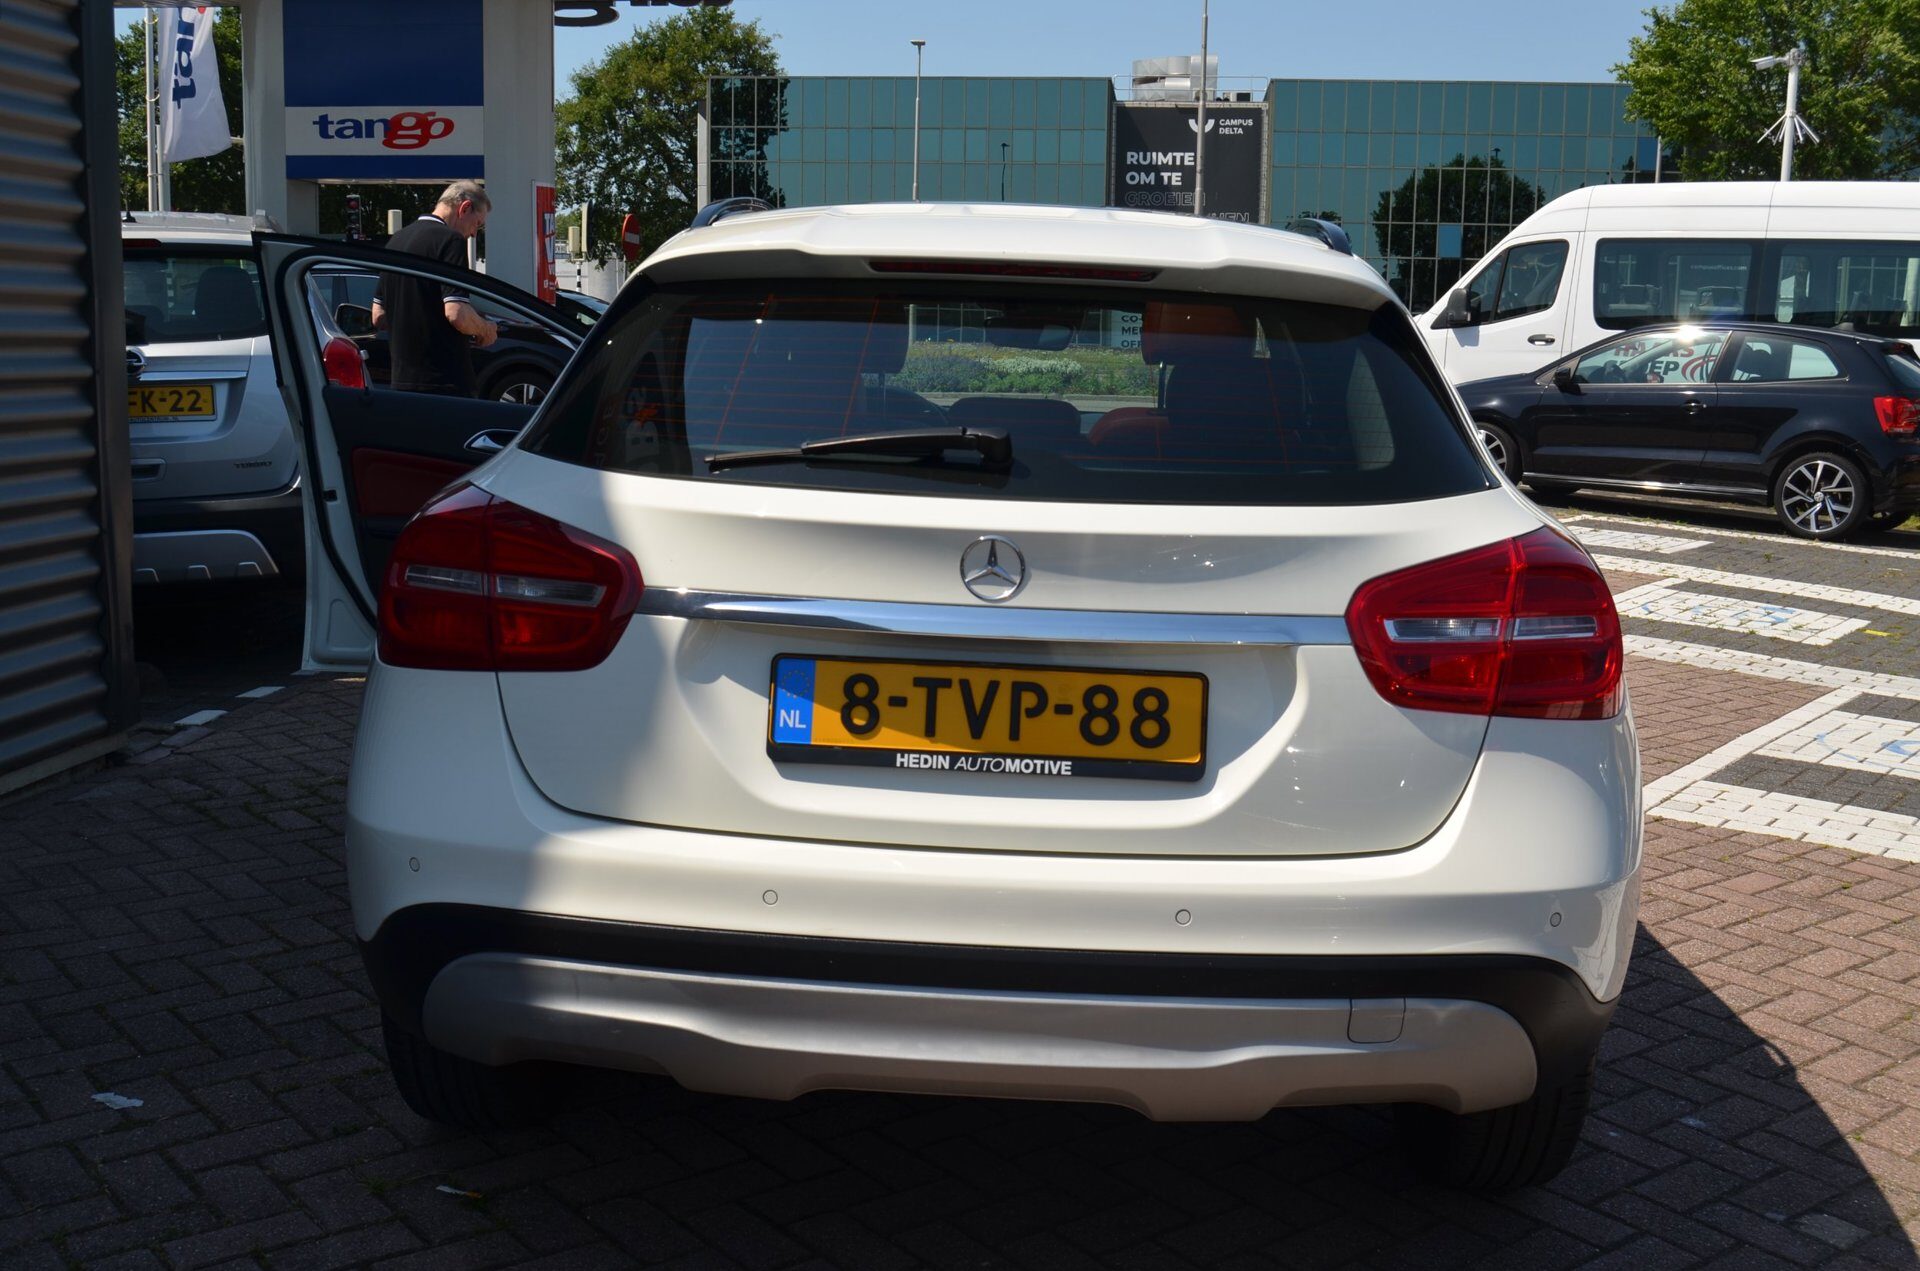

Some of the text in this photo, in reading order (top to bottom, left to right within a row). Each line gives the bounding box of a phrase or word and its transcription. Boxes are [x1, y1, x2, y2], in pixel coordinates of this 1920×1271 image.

[312, 111, 455, 150] tango
[1219, 118, 1253, 126] CAMPUS
[1219, 127, 1243, 135] DELTA
[1126, 151, 1195, 166] RUIMTE
[1125, 171, 1183, 186] OM TE
[779, 708, 806, 729] NL
[840, 673, 1171, 748] 8-TVP-88
[896, 753, 1072, 775] HEDIN AUTOMOTIVE
